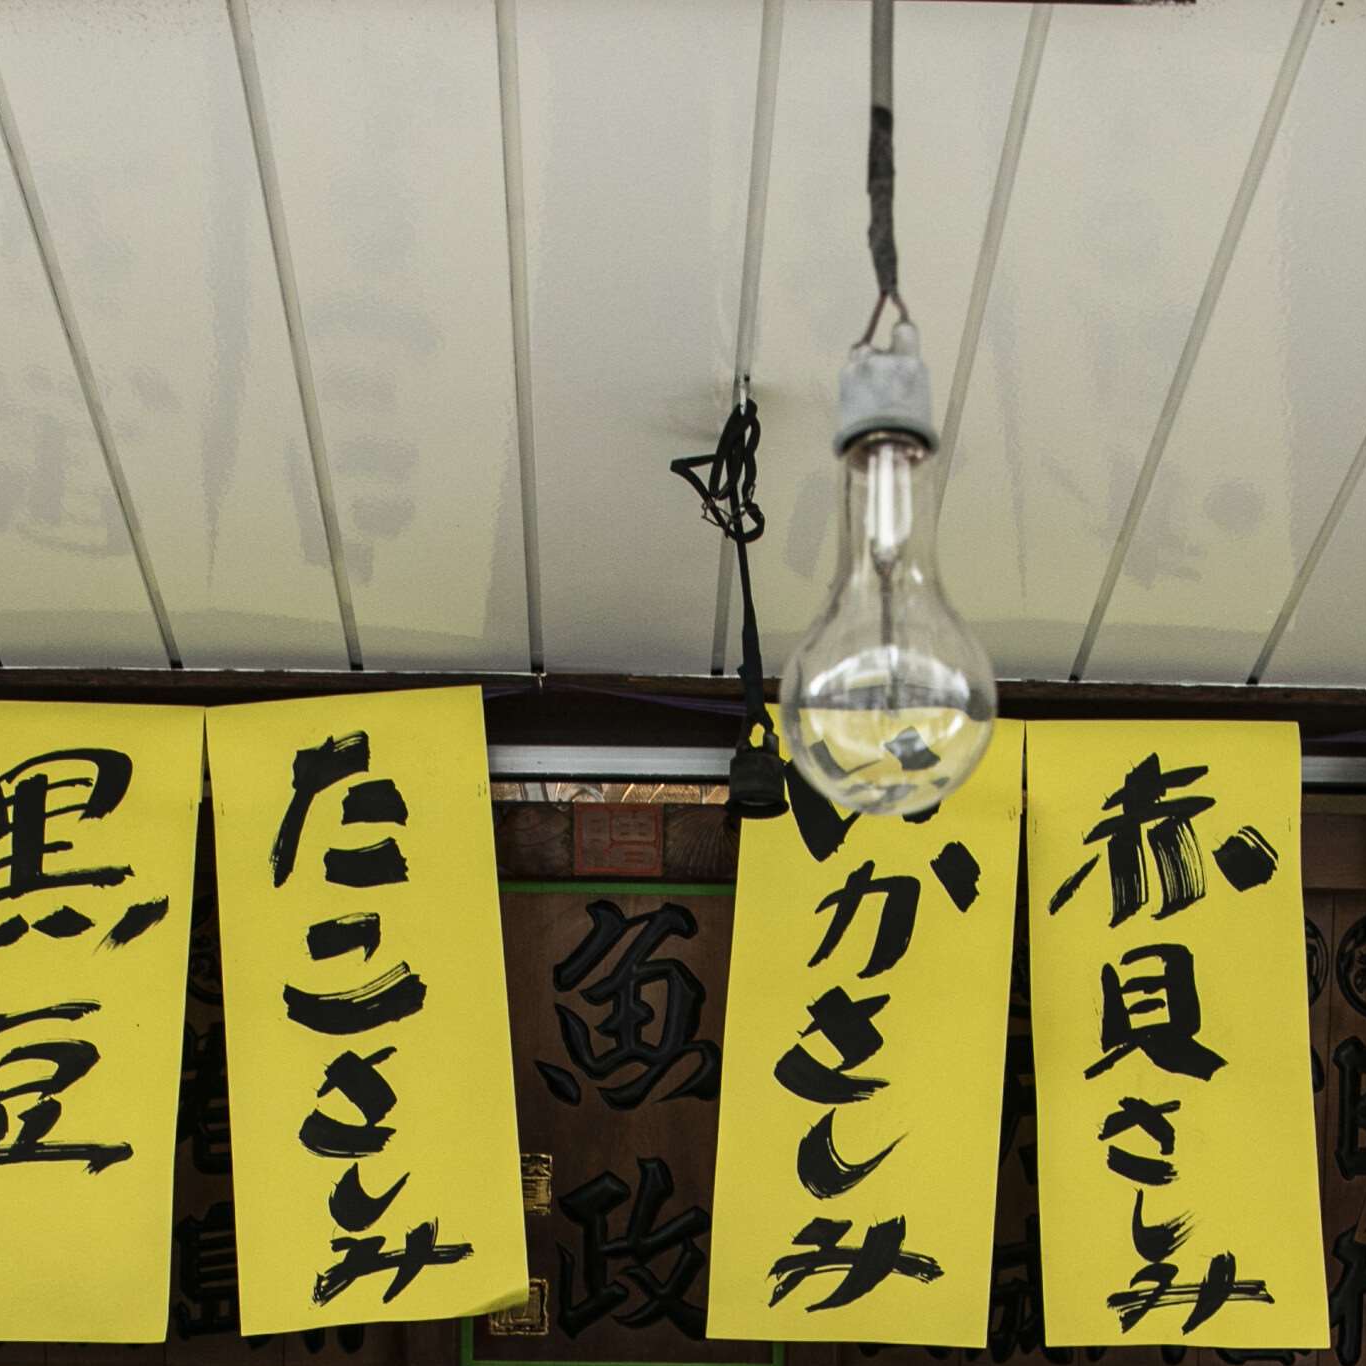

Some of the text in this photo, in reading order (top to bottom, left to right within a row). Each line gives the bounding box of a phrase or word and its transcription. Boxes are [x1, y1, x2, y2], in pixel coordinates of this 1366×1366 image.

[270, 730, 475, 1307] たこさしみ
[535, 900, 723, 1340] 魚政
[1048, 751, 1279, 1336] 赤貝さしみ
